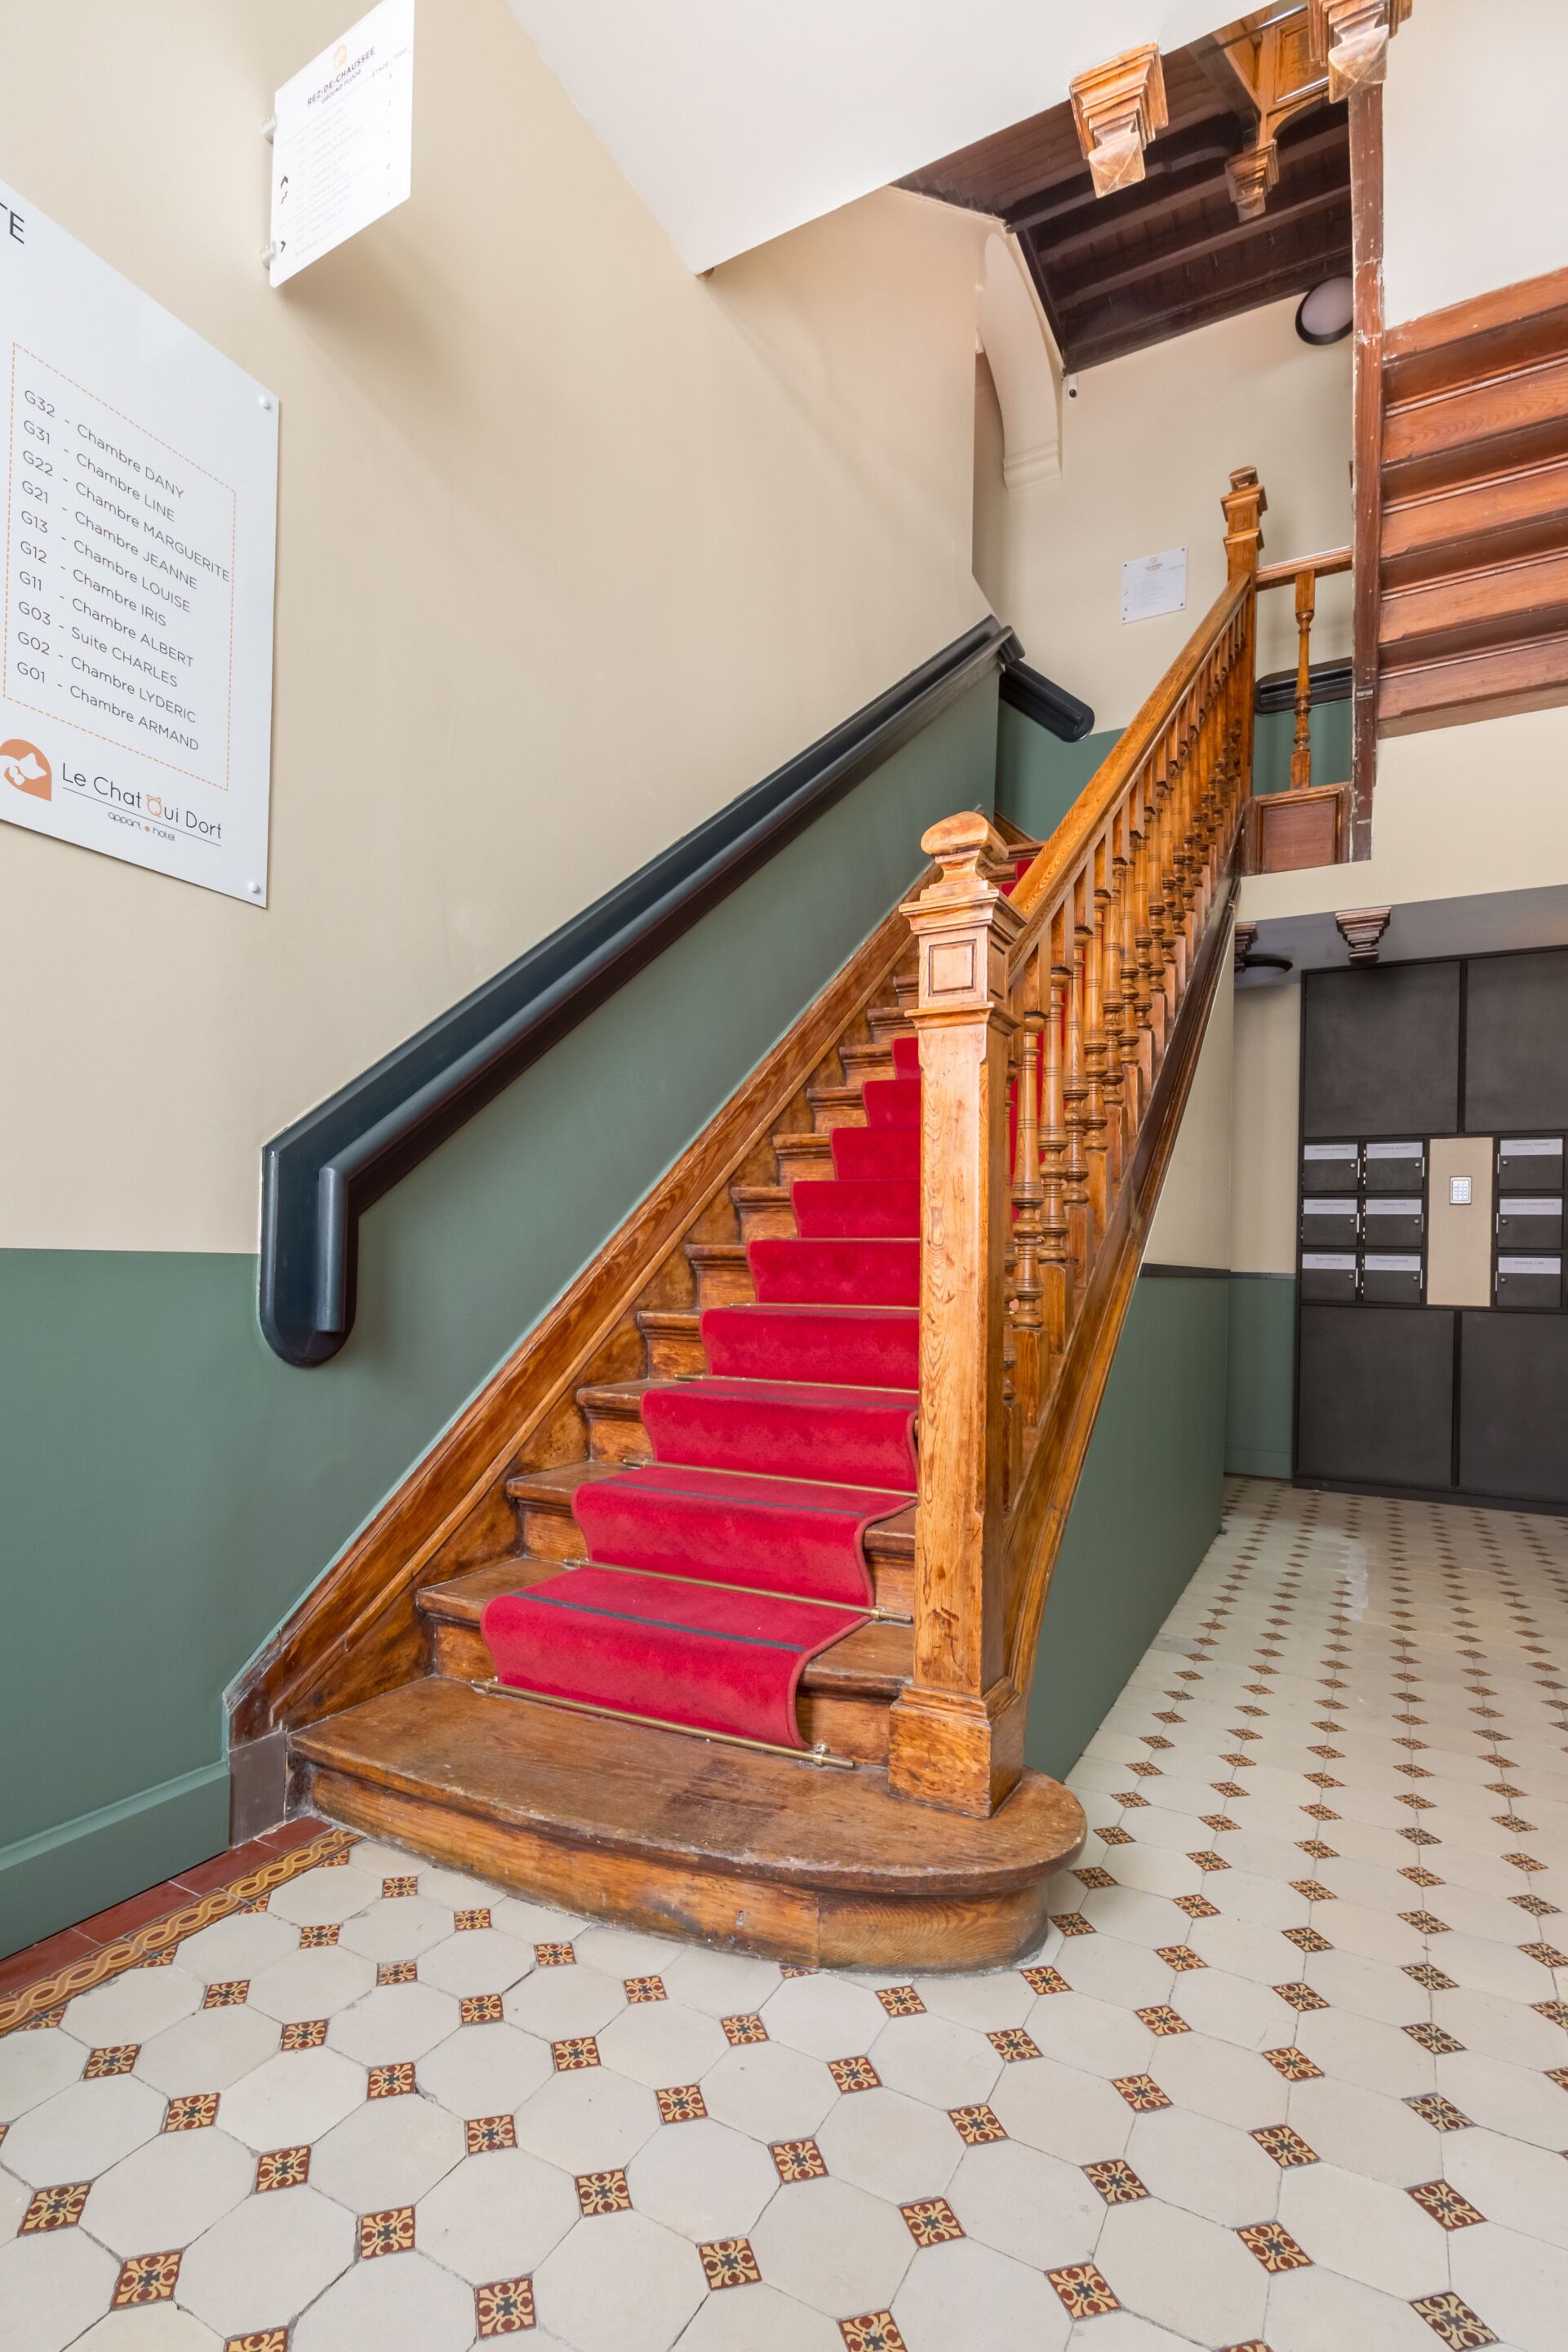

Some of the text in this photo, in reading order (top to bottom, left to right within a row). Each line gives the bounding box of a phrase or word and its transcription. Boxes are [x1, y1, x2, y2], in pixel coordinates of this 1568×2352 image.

[322, 69, 362, 104] GROUND FLOOR
[24, 390, 56, 418] G32
[78, 424, 141, 473] Chambre
[144, 467, 184, 500] DANY
[24, 420, 51, 445] G31
[77, 453, 140, 500] Chambre
[144, 494, 175, 522] LINE
[22, 480, 48, 505] G21
[75, 511, 139, 556] Chambre
[143, 551, 198, 590] JEANNE
[23, 450, 53, 478] G22
[76, 482, 140, 528] Chambre
[144, 522, 230, 582] MARGUERITE
[20, 540, 47, 564] G12
[73, 569, 137, 611] Chambre
[141, 604, 167, 627] IRIS
[21, 510, 48, 534] G13
[73, 540, 138, 583] Chambre
[142, 576, 191, 613] LOUISE
[20, 571, 42, 591] G11
[72, 598, 136, 639] Chambre
[140, 634, 194, 668] ALBERT
[71, 627, 108, 653] Suite
[112, 647, 178, 687] CHARLES
[70, 686, 134, 722] Chambre
[139, 717, 199, 750] ARMAND
[71, 657, 135, 695] Chambre
[140, 687, 196, 723] LYDERIC
[62, 763, 87, 787] Le
[93, 776, 141, 809] Chat
[186, 811, 222, 839] Dort
[108, 811, 142, 830] appart
